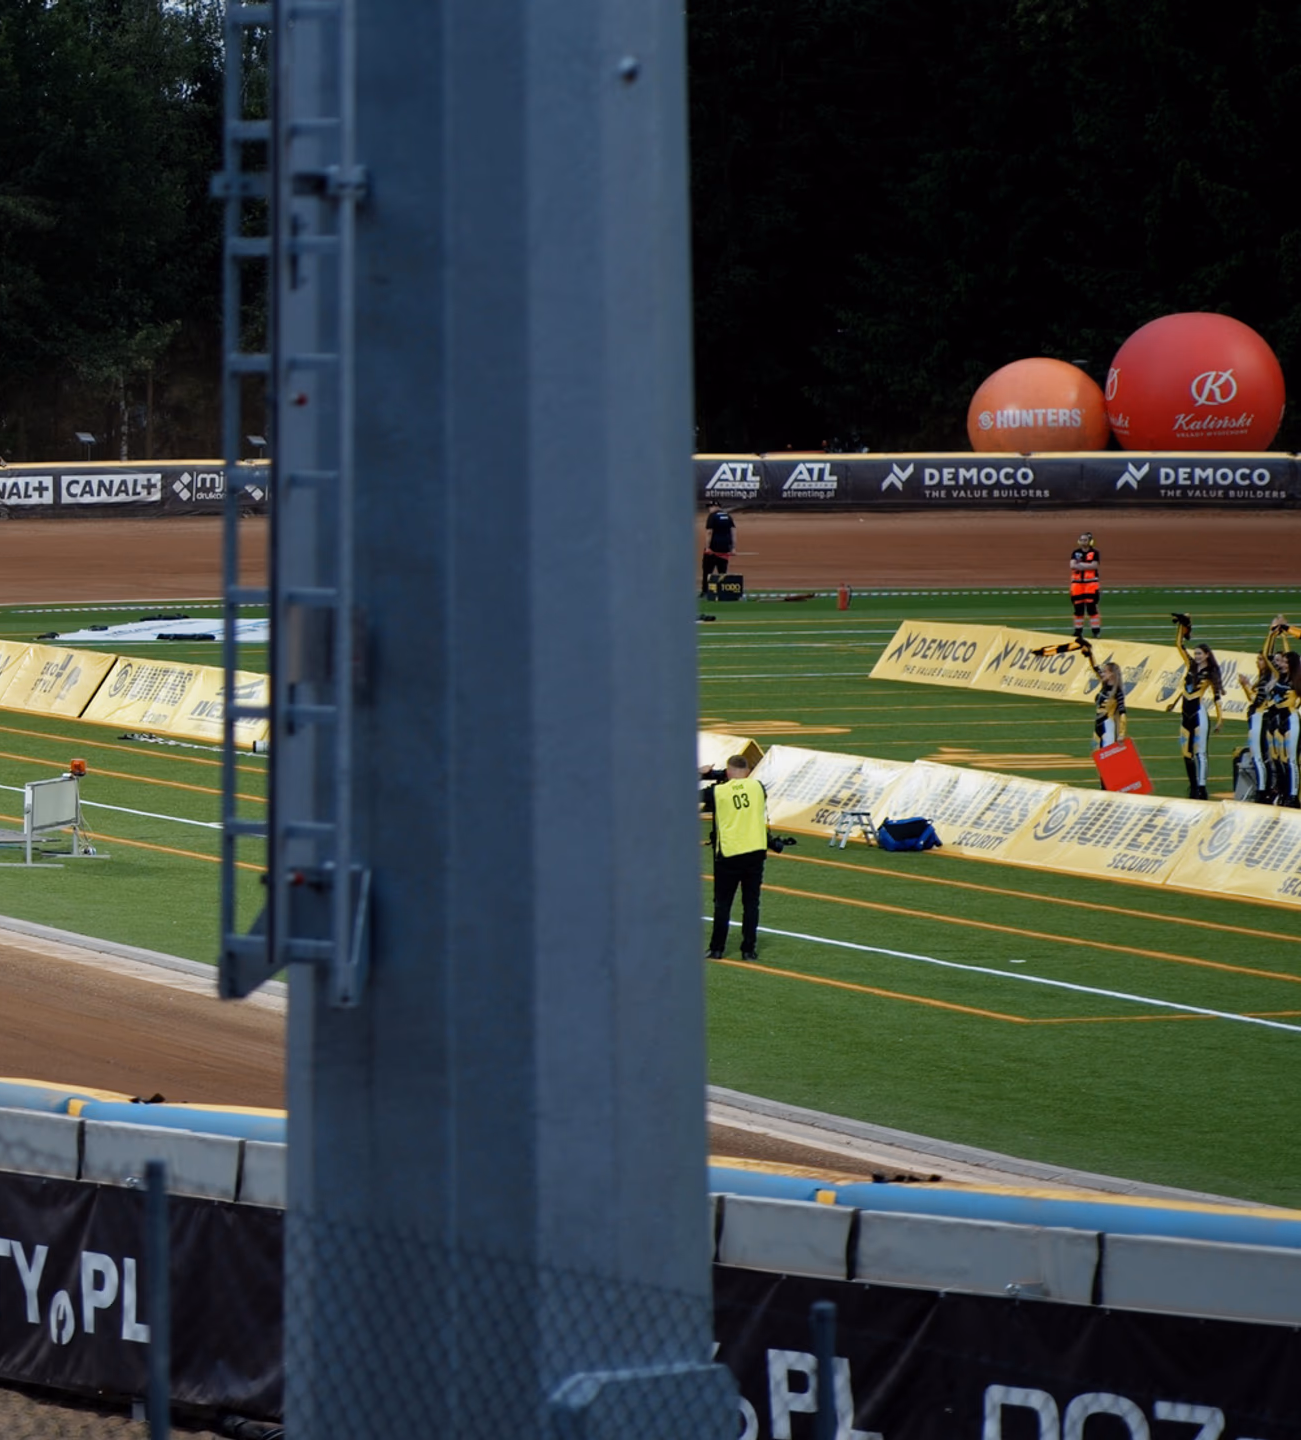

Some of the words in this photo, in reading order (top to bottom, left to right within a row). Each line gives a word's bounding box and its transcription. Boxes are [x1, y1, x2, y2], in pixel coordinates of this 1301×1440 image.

[996, 409, 1082, 428] HUNTERS
[1173, 412, 1255, 431] Kaliński
[197, 471, 226, 492] mj
[705, 462, 760, 489] ATL
[782, 462, 837, 489] ATL
[924, 467, 1034, 486] DEMOCO
[1160, 467, 1271, 486] DEMOCO
[65, 478, 158, 498] CANAL+
[705, 490, 757, 499] atlrenting.pl
[782, 490, 835, 499] atlrenting.pl
[994, 489, 1050, 498] BUILDERS
[1160, 490, 1183, 498] THE
[1188, 490, 1224, 498] VALUE
[1229, 490, 1287, 499] BUILDERS
[911, 637, 977, 663] DEMOCO
[1010, 647, 1076, 675] DEMOCO
[732, 793, 750, 810] 03
[1058, 800, 1193, 858] HUNTERS
[952, 830, 1007, 850] SECURITY
[1107, 853, 1167, 875] SECURITY
